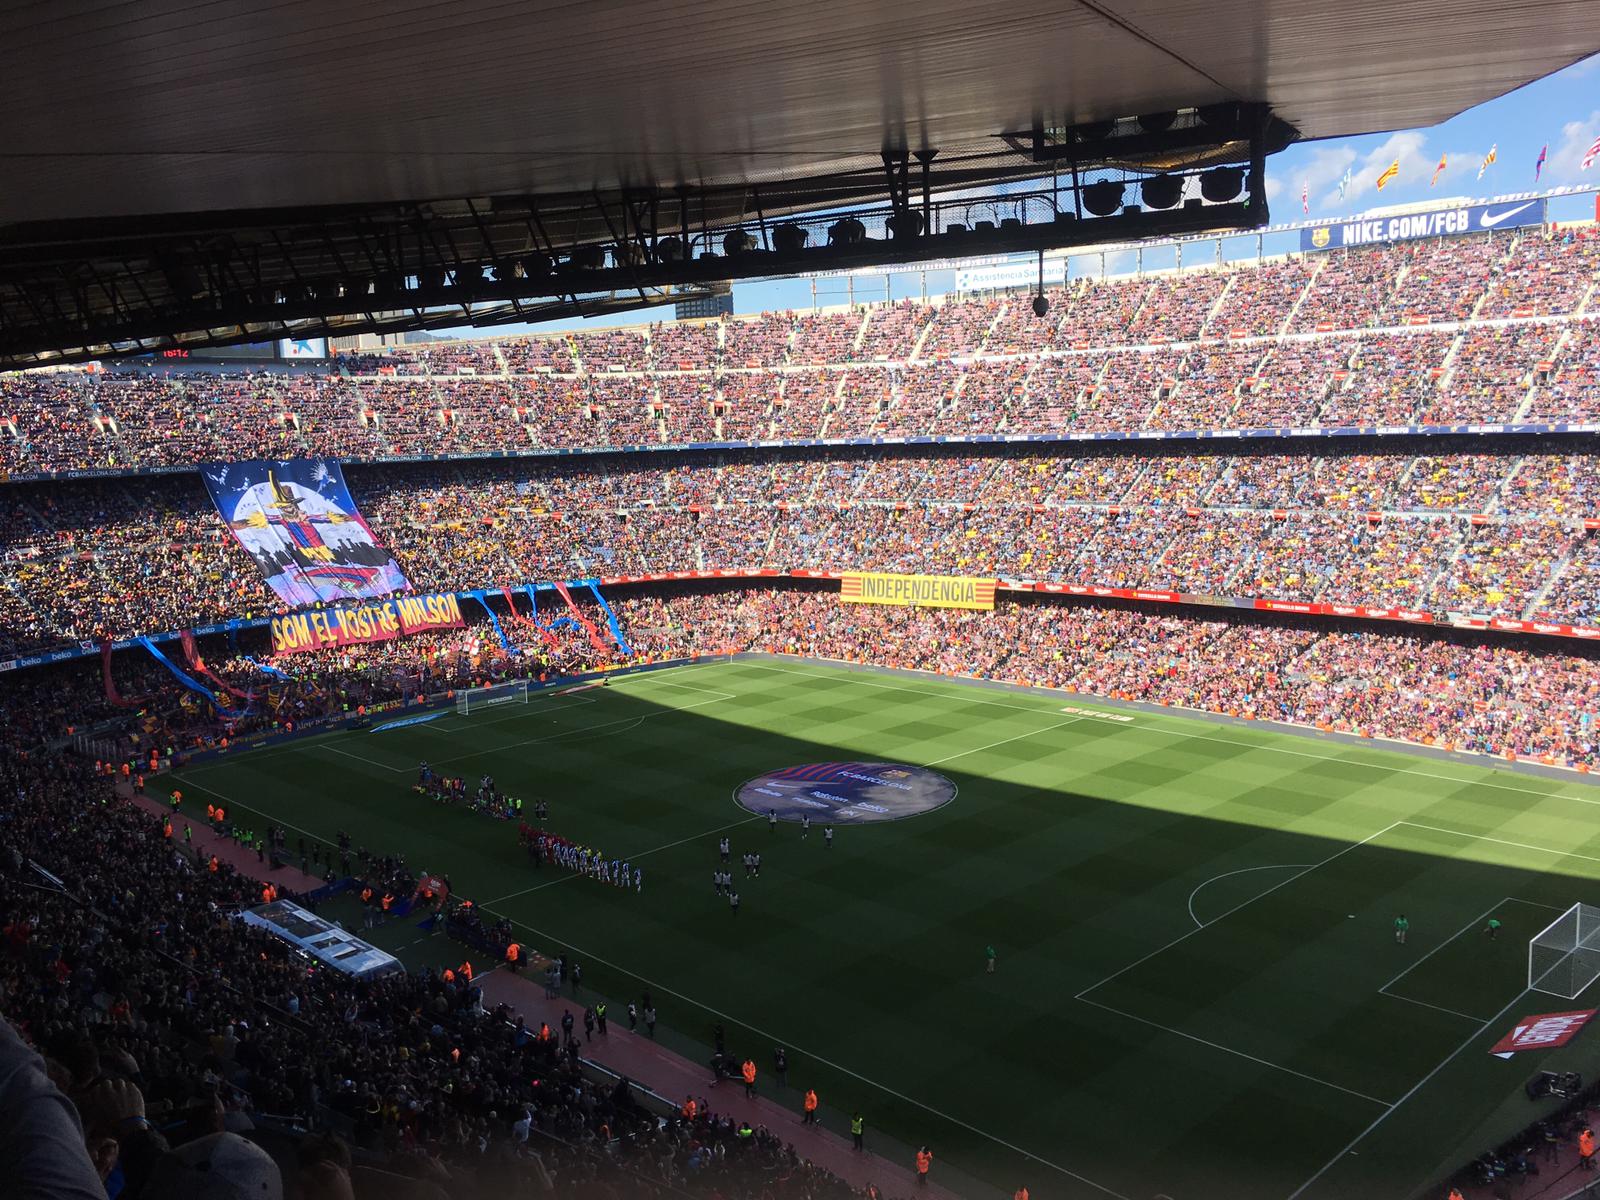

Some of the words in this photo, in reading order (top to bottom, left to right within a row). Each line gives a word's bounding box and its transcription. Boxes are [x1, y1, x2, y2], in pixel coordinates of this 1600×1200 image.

[1343, 209, 1469, 245] NIKE.COM/FCB
[163, 349, 188, 358] 16:12
[68, 469, 122, 478] FCBARCELONA.COM
[150, 465, 198, 473] FCBARCELONA.CO
[861, 576, 975, 603] INDEPENDÈNCIA
[271, 614, 313, 651] SOM
[311, 612, 337, 643] EL
[335, 602, 400, 640] VOSTRE
[396, 593, 462, 628] MALSON
[196, 626, 216, 635] beko
[111, 641, 131, 650] beko
[51, 650, 72, 661] beko
[21, 656, 42, 667] beko
[852, 773, 913, 791] BARCELONA
